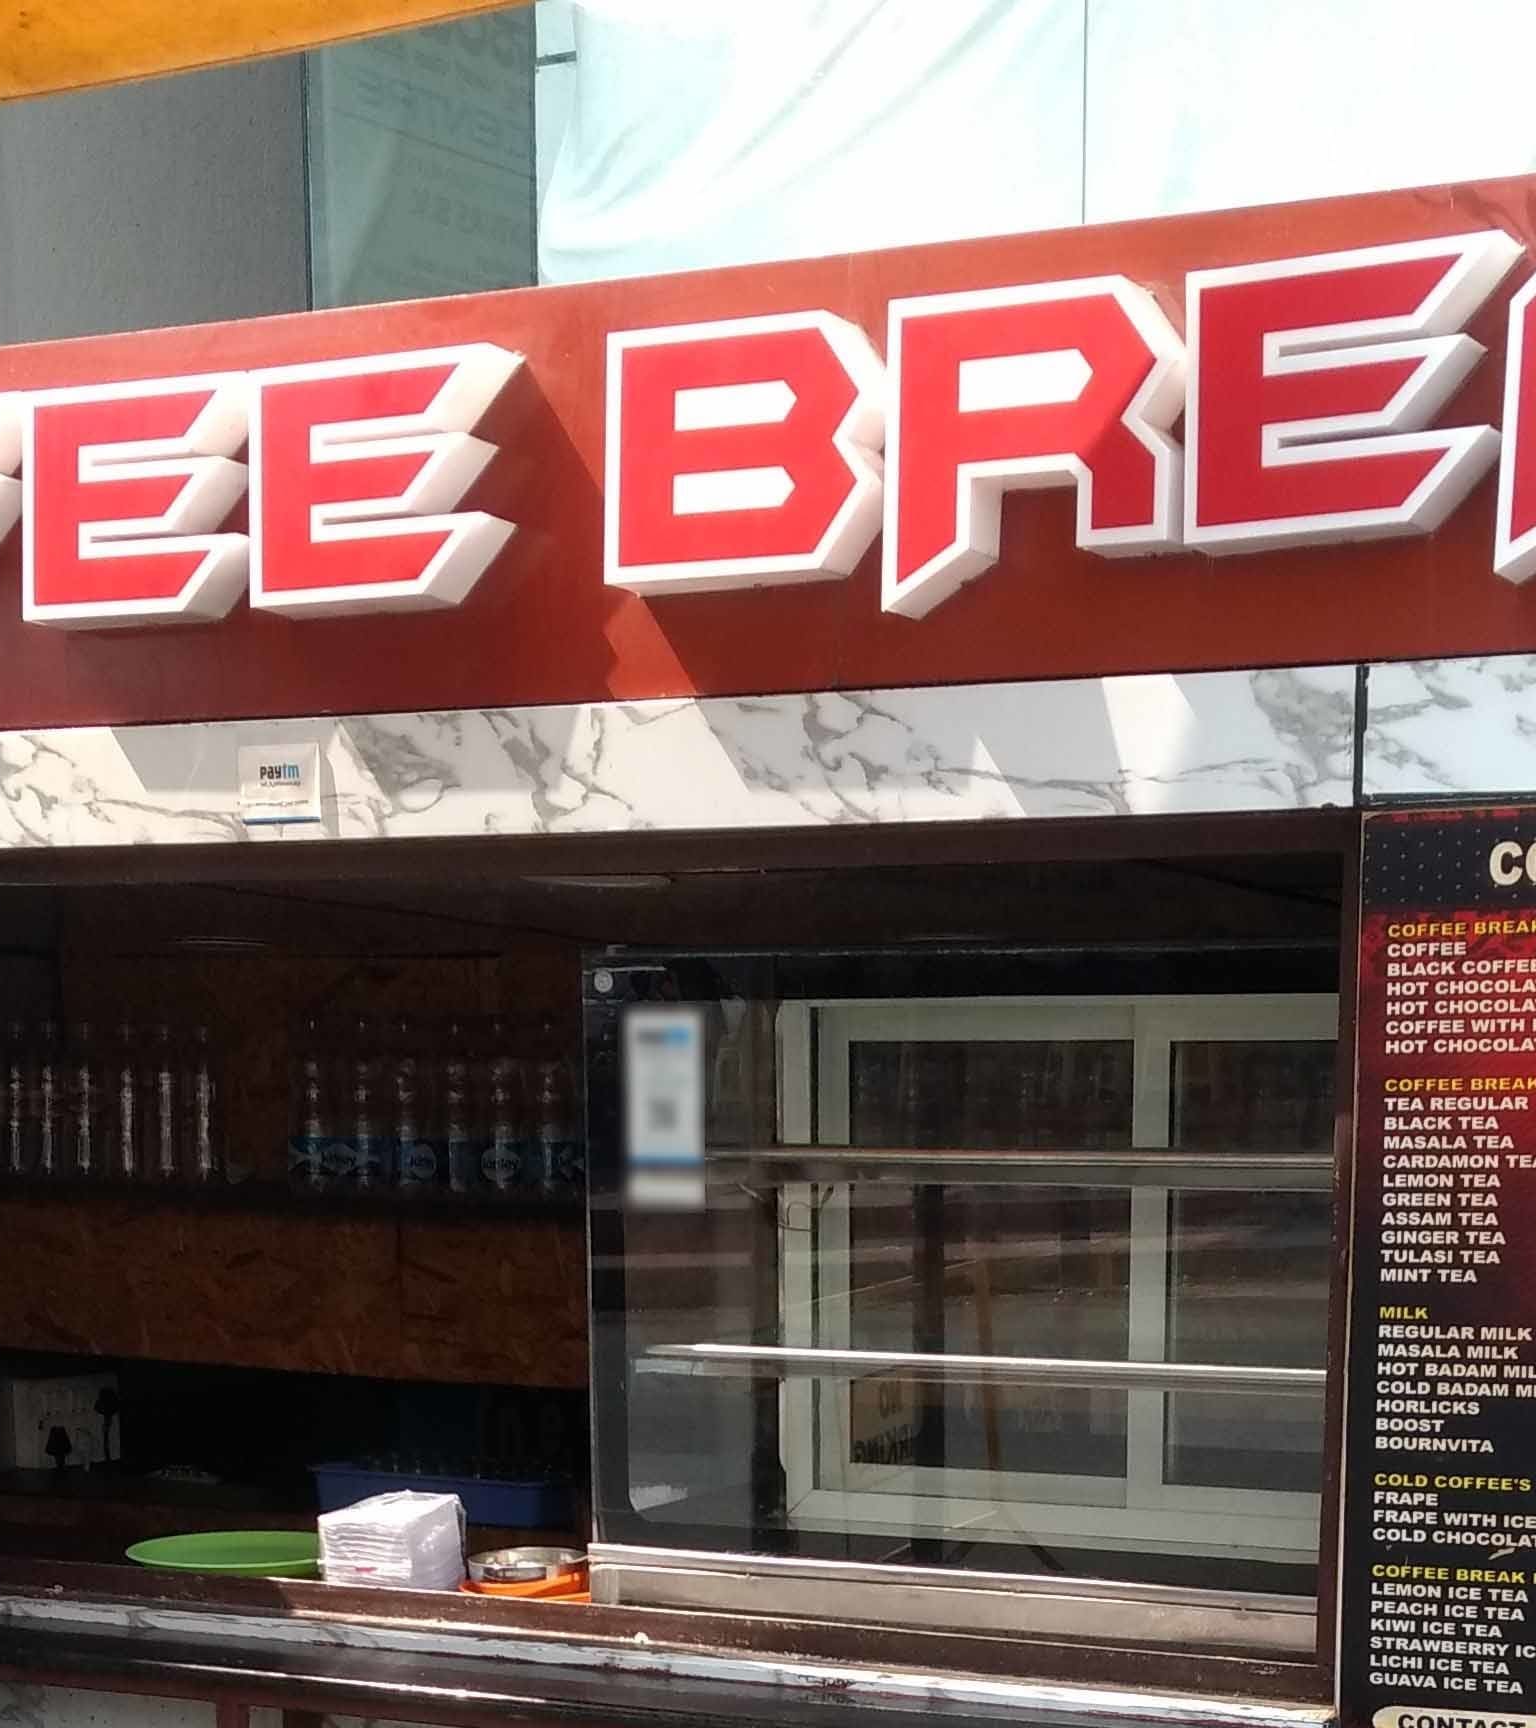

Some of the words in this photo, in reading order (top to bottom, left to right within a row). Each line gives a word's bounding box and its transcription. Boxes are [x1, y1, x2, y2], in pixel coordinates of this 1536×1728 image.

[1388, 923, 1465, 937] COFFEE
[1388, 942, 1466, 957] COFFEE
[1387, 982, 1429, 995] HOT
[1386, 1020, 1464, 1034] COFFEE
[1471, 1019, 1524, 1032] WITH
[1386, 1079, 1462, 1091] COFFEE
[1384, 1098, 1424, 1111] TEA
[1431, 1097, 1528, 1110] REGULAR
[1384, 1136, 1466, 1149] MASALA
[1473, 1136, 1514, 1148] TEA
[1384, 1155, 1498, 1168] CARDAMON
[1384, 1174, 1453, 1187] LEMON
[1460, 1175, 1500, 1187] TEA
[1382, 1212, 1451, 1225] ASSAM
[1458, 1213, 1498, 1225] TEA
[1381, 1269, 1431, 1282] MINT
[1437, 1269, 1477, 1282] TEA
[1380, 1307, 1428, 1319] MILK
[1379, 1325, 1474, 1339] REGULAR
[1481, 1327, 1532, 1340] MILK
[1377, 1381, 1430, 1394] COLD
[1437, 1383, 1508, 1396] BADAM
[1377, 1399, 1479, 1414] HORLICKS
[1376, 1437, 1493, 1452] BOURNVITA
[1374, 1491, 1438, 1506] FRAPE
[1373, 1528, 1426, 1542] COLD
[1373, 1565, 1448, 1579] COFFEE
[1456, 1569, 1524, 1583] BREAK
[1371, 1619, 1415, 1632] KIWI
[1423, 1622, 1455, 1635] ICE
[1462, 1624, 1502, 1637] TEA
[1371, 1636, 1509, 1656] STRAWBERRY
